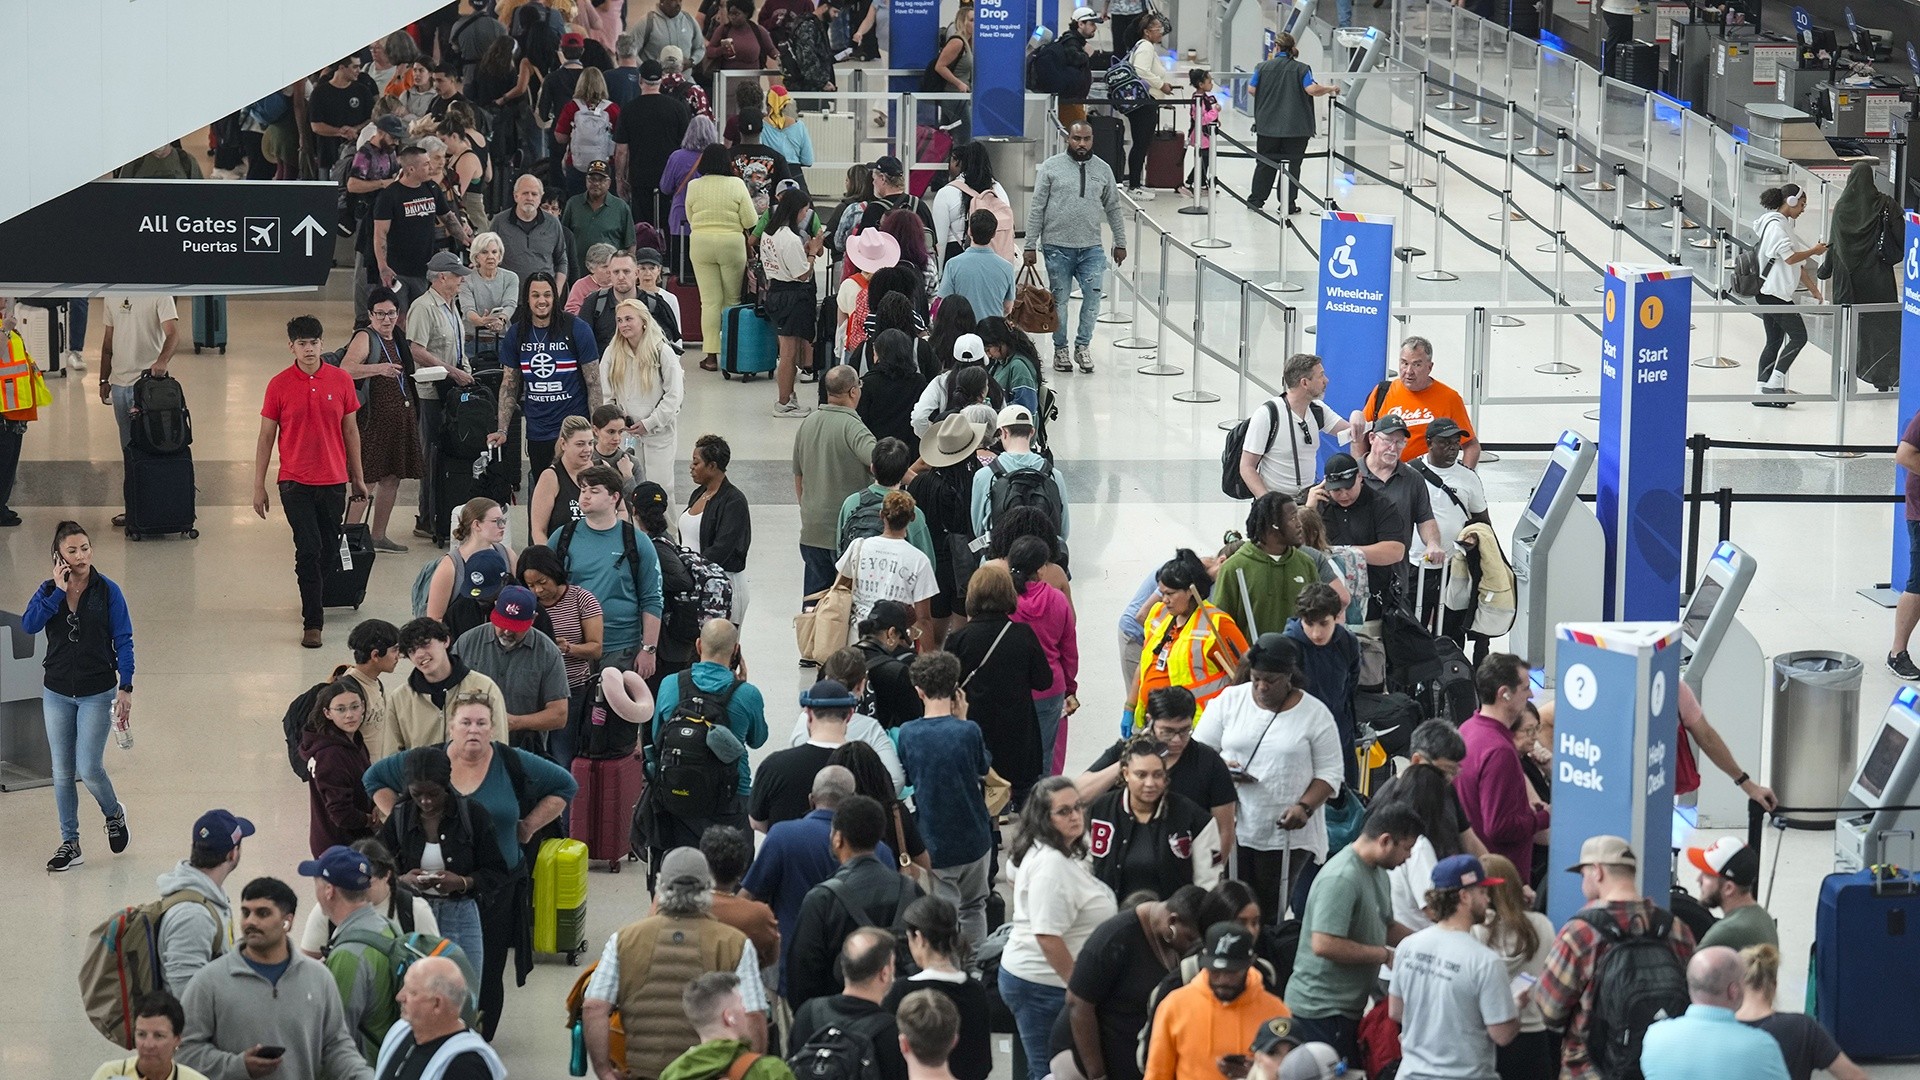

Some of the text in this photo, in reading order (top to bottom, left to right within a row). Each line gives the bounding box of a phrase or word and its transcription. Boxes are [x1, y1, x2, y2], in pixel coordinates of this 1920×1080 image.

[980, 8, 1008, 20] Drop
[1796, 11, 1808, 26] 10
[138, 215, 237, 233] All Gates
[182, 240, 238, 253] Puertas
[1326, 286, 1384, 301] Wheelchair
[1325, 300, 1378, 315] Assistance
[1648, 304, 1655, 320] 1
[1603, 339, 1617, 359] Start
[1638, 346, 1669, 364] Start
[1603, 359, 1616, 380] Here
[1637, 368, 1668, 384] Here
[1560, 732, 1601, 767] Help
[1648, 740, 1666, 767] Help
[1559, 761, 1604, 792] Desk
[1647, 766, 1666, 796] Desk
[1091, 819, 1115, 858] B
